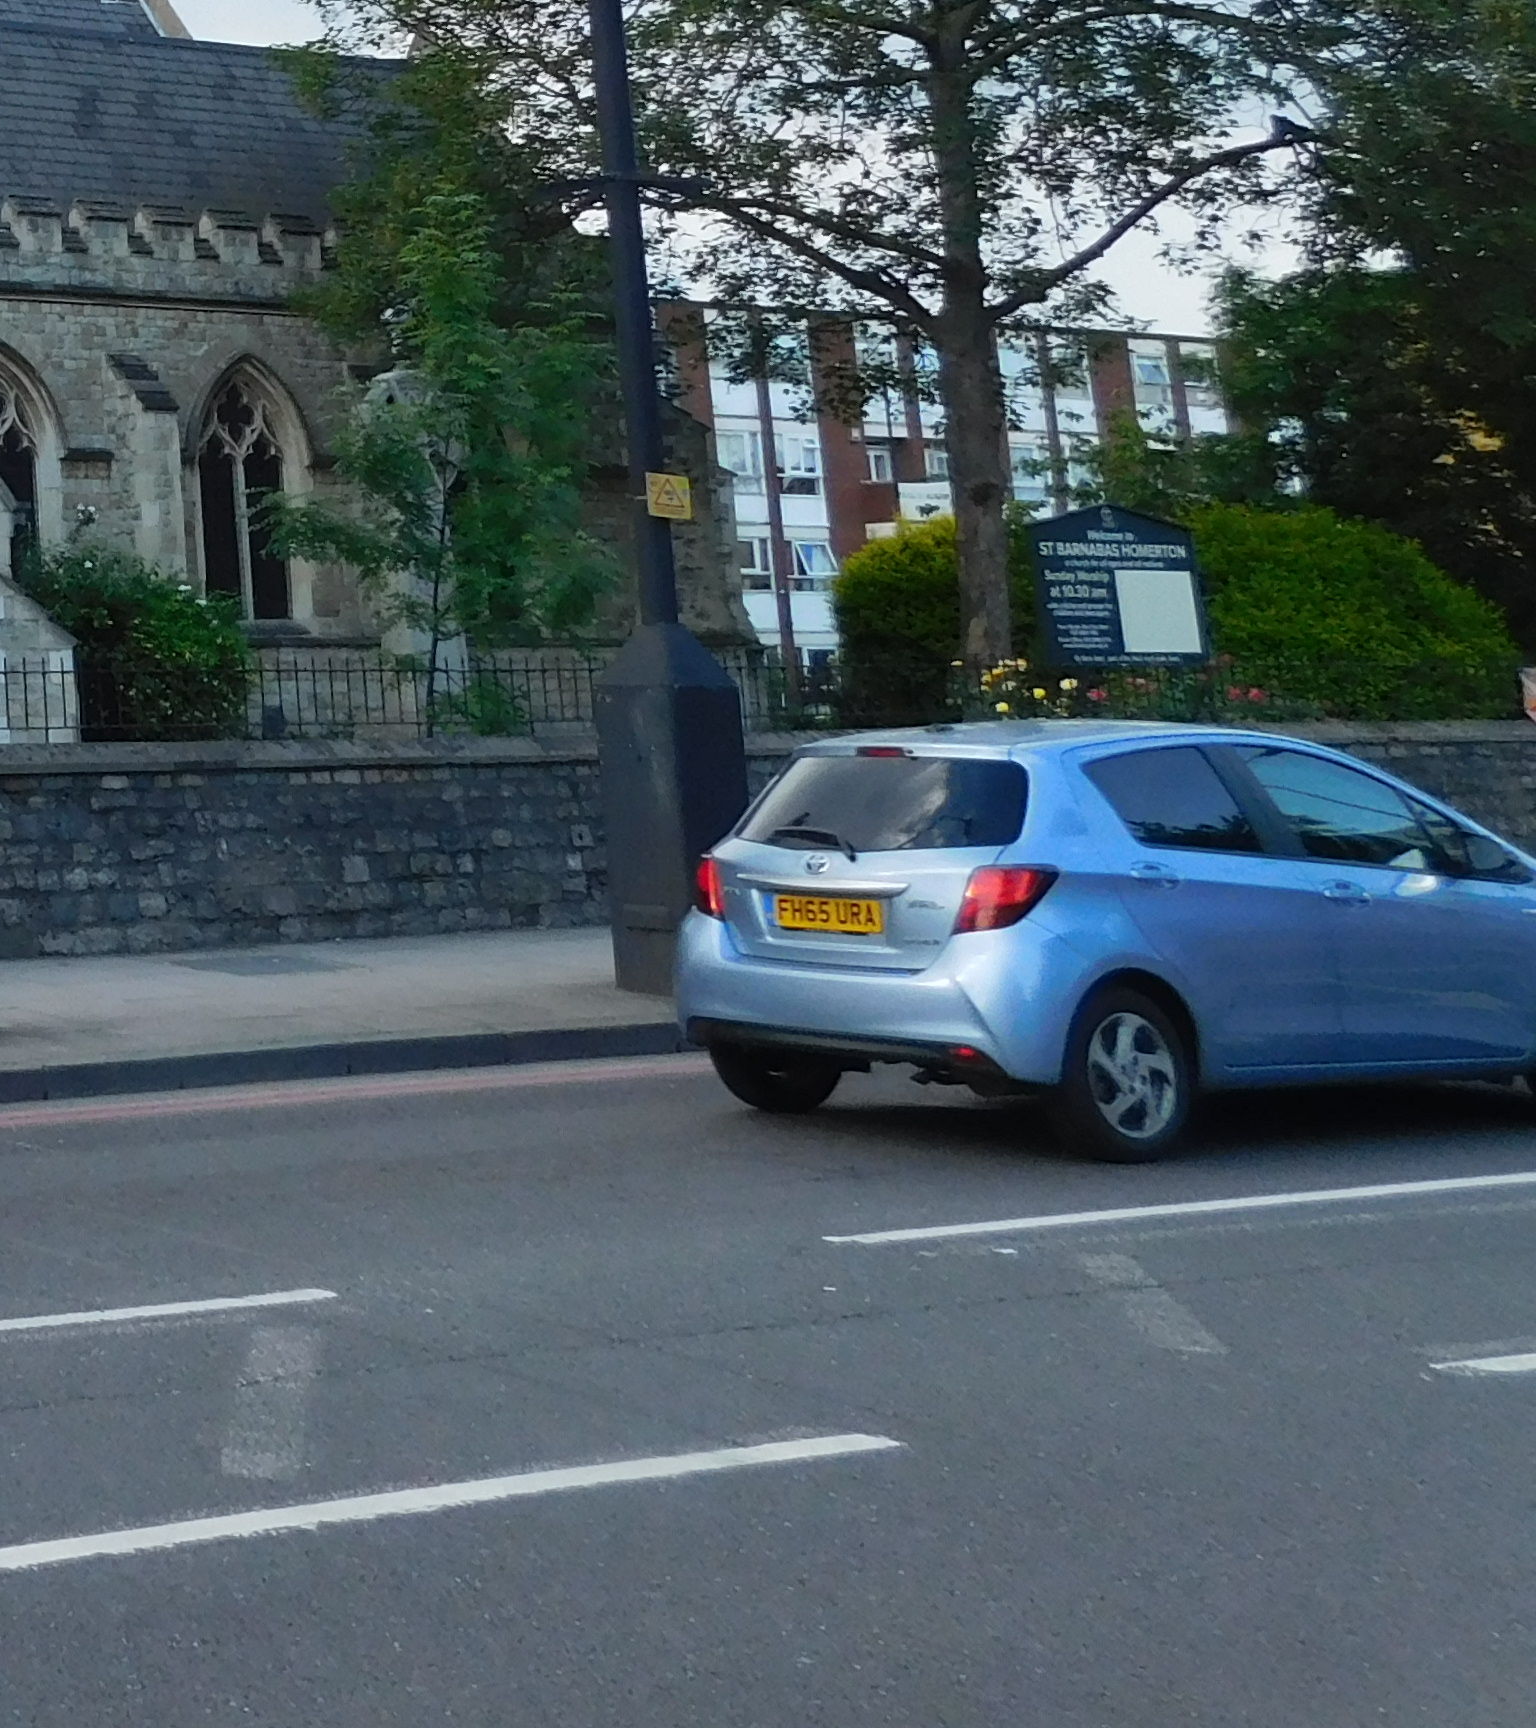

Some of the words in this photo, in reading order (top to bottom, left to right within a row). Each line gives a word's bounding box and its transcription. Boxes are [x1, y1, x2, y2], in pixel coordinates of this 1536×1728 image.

[1038, 541, 1054, 556] ST
[1056, 541, 1119, 557] BARNABAS
[1121, 543, 1187, 559] HOMERTON
[1043, 569, 1076, 583] Sunday
[1049, 586, 1061, 598] at
[1062, 584, 1089, 598] 10.30
[777, 898, 830, 924] FH65
[835, 901, 877, 927] URA
